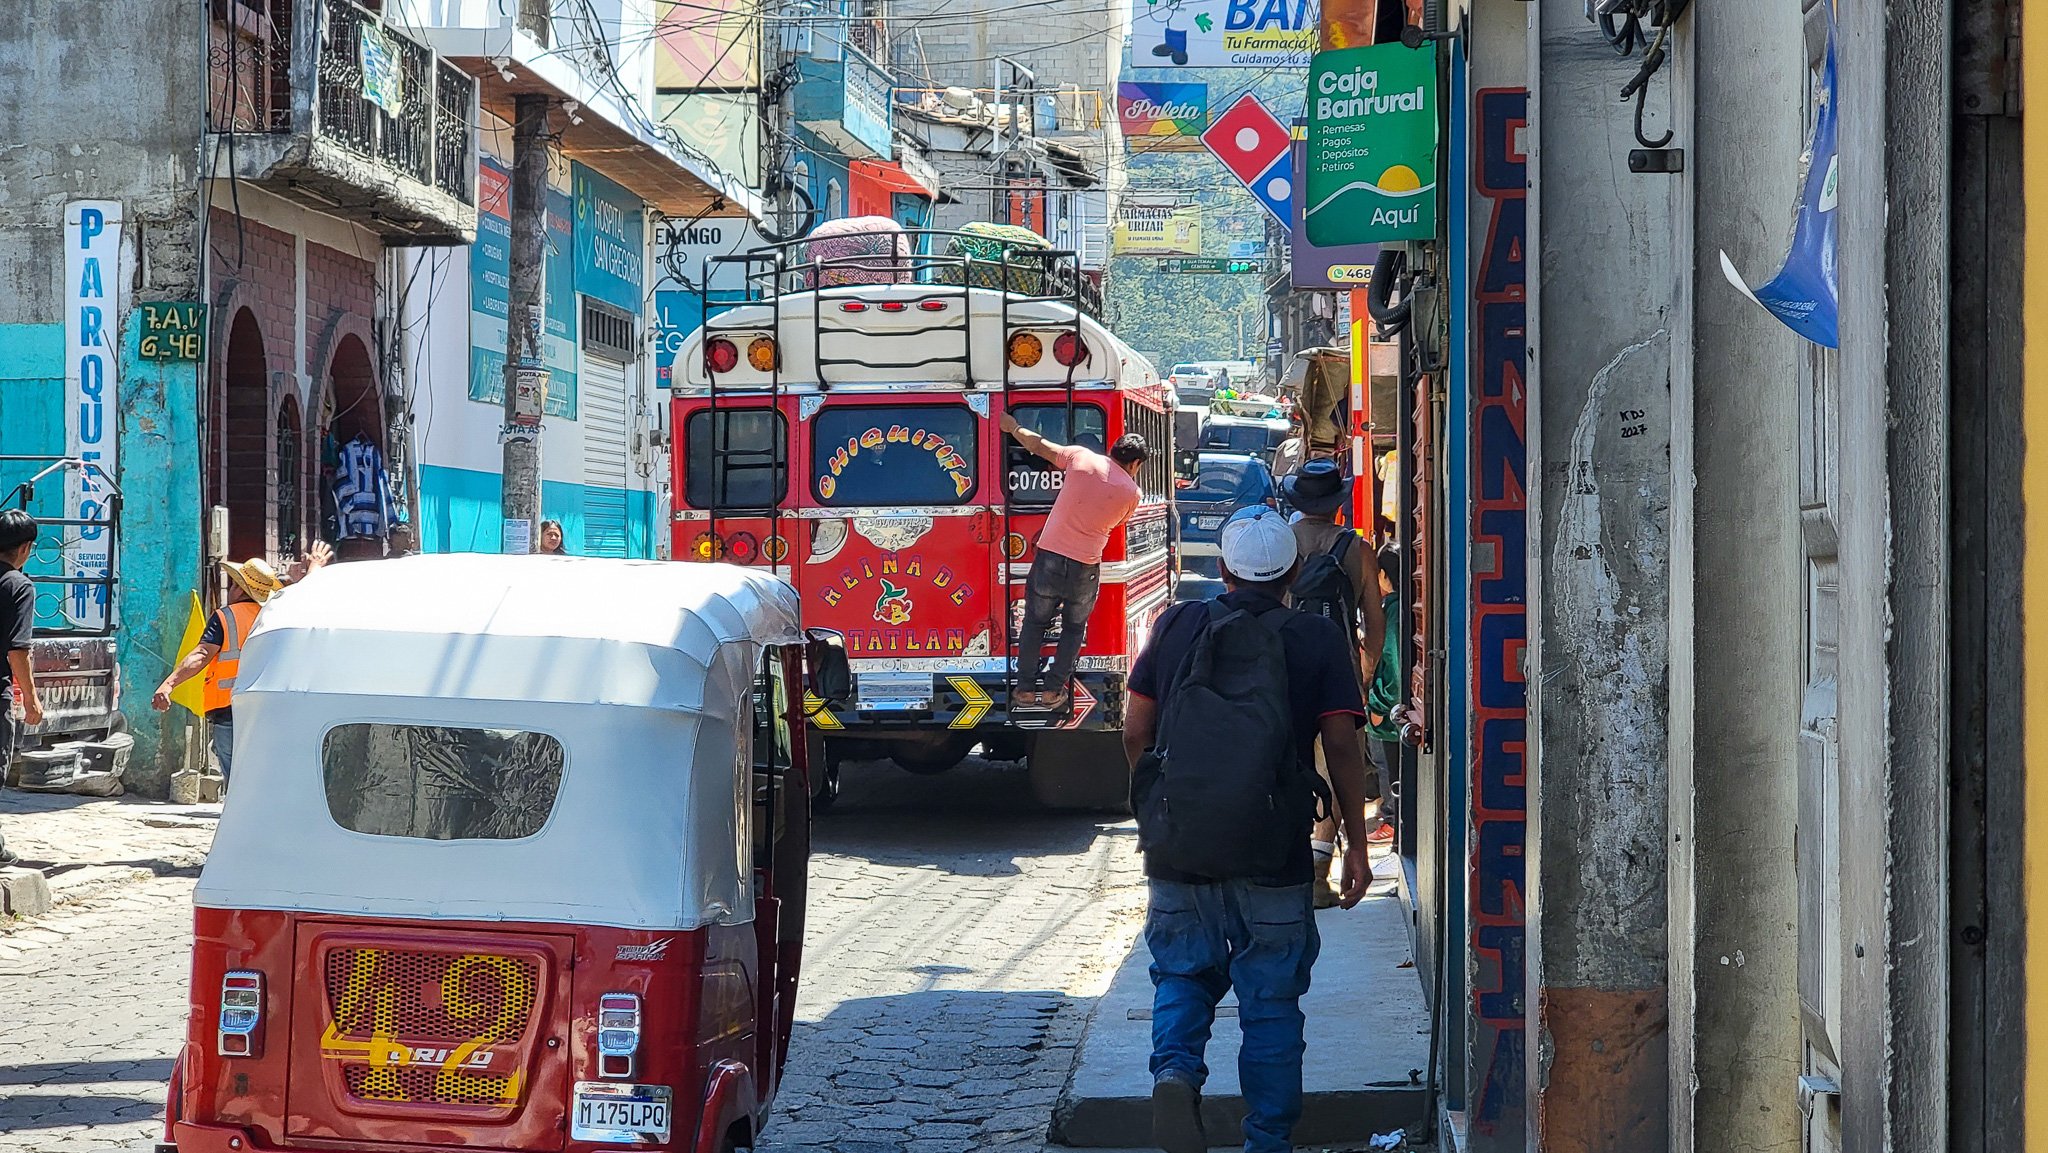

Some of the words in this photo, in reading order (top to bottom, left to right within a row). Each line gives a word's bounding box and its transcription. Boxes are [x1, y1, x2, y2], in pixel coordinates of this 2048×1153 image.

[1226, 37, 1242, 49] Tu
[1244, 37, 1308, 50] Farmacia
[1231, 53, 1285, 65] Cuidamos
[1318, 66, 1378, 97] Caja
[1124, 98, 1201, 120] Paleta
[1317, 86, 1424, 120] Banrural
[1322, 122, 1366, 135] Remesas
[1322, 137, 1352, 149] Pagos
[1322, 147, 1369, 161] Depósitos
[1321, 162, 1355, 172] Retiros
[594, 196, 626, 242] HOSPITAL
[1119, 207, 1173, 220] FARMACIAS
[1370, 203, 1421, 229] Aquí
[1128, 220, 1163, 231] URIZAR
[594, 235, 608, 272] SAN
[608, 242, 642, 287] GREGORIO
[1346, 269, 1372, 279] 468
[79, 208, 104, 541] PARQUEO
[1621, 423, 1648, 438] 2027
[819, 424, 973, 498] CHIQUITITA
[1008, 471, 1067, 490] C078B
[78, 553, 107, 562] SERVICIO
[817, 552, 922, 608] REINA
[931, 565, 974, 607] DE
[838, 628, 965, 651] TATLAN
[43, 677, 96, 704] TOYOTA
[580, 1102, 592, 1125] M
[596, 1102, 665, 1128] 175LPQ
